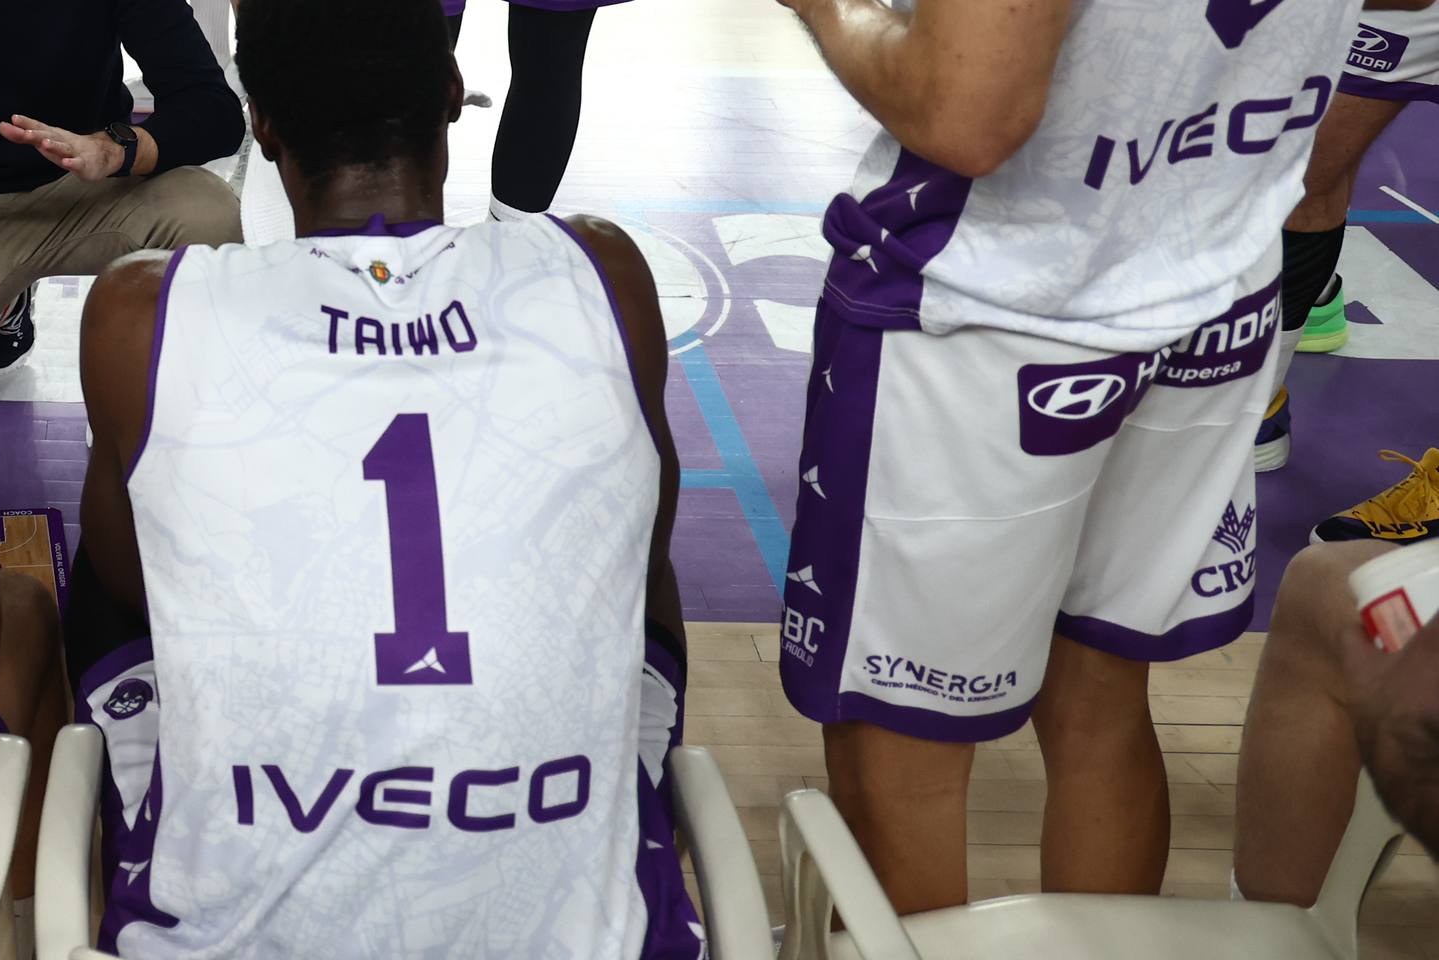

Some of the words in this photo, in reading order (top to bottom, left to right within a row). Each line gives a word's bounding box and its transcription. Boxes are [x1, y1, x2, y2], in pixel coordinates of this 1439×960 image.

[1348, 51, 1392, 72] NDAI
[1084, 74, 1332, 191] IVECO
[320, 300, 478, 356] TAIWO
[1161, 360, 1242, 384] upersa
[362, 413, 473, 686] 1
[782, 607, 825, 655] BC
[232, 755, 591, 834] IVECO
